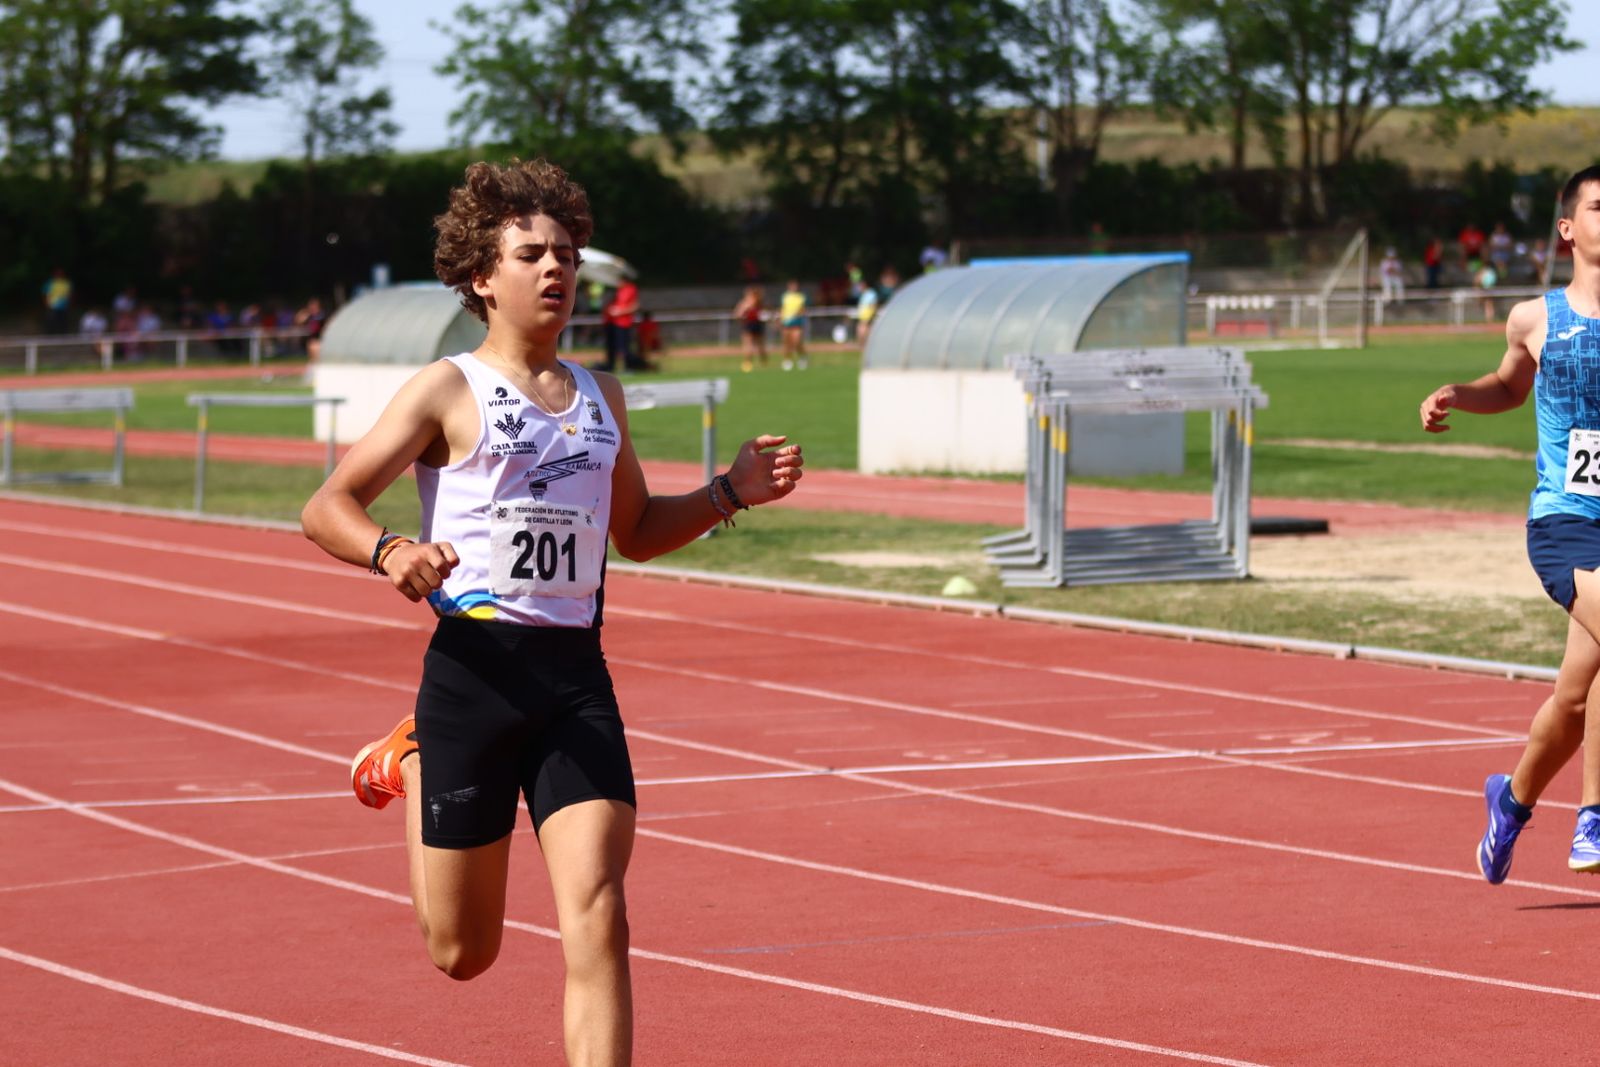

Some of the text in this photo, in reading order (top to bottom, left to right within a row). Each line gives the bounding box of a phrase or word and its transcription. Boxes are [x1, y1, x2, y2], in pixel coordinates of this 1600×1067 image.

[488, 399, 521, 407] VIATOR
[583, 427, 615, 437] Ayuntamiento
[512, 441, 537, 449] RURAL
[592, 435, 616, 446] Salamanca
[555, 509, 579, 517] ATLETISMO
[525, 516, 532, 524] DE
[532, 517, 555, 525] CASTILLA
[510, 530, 576, 582] 201
